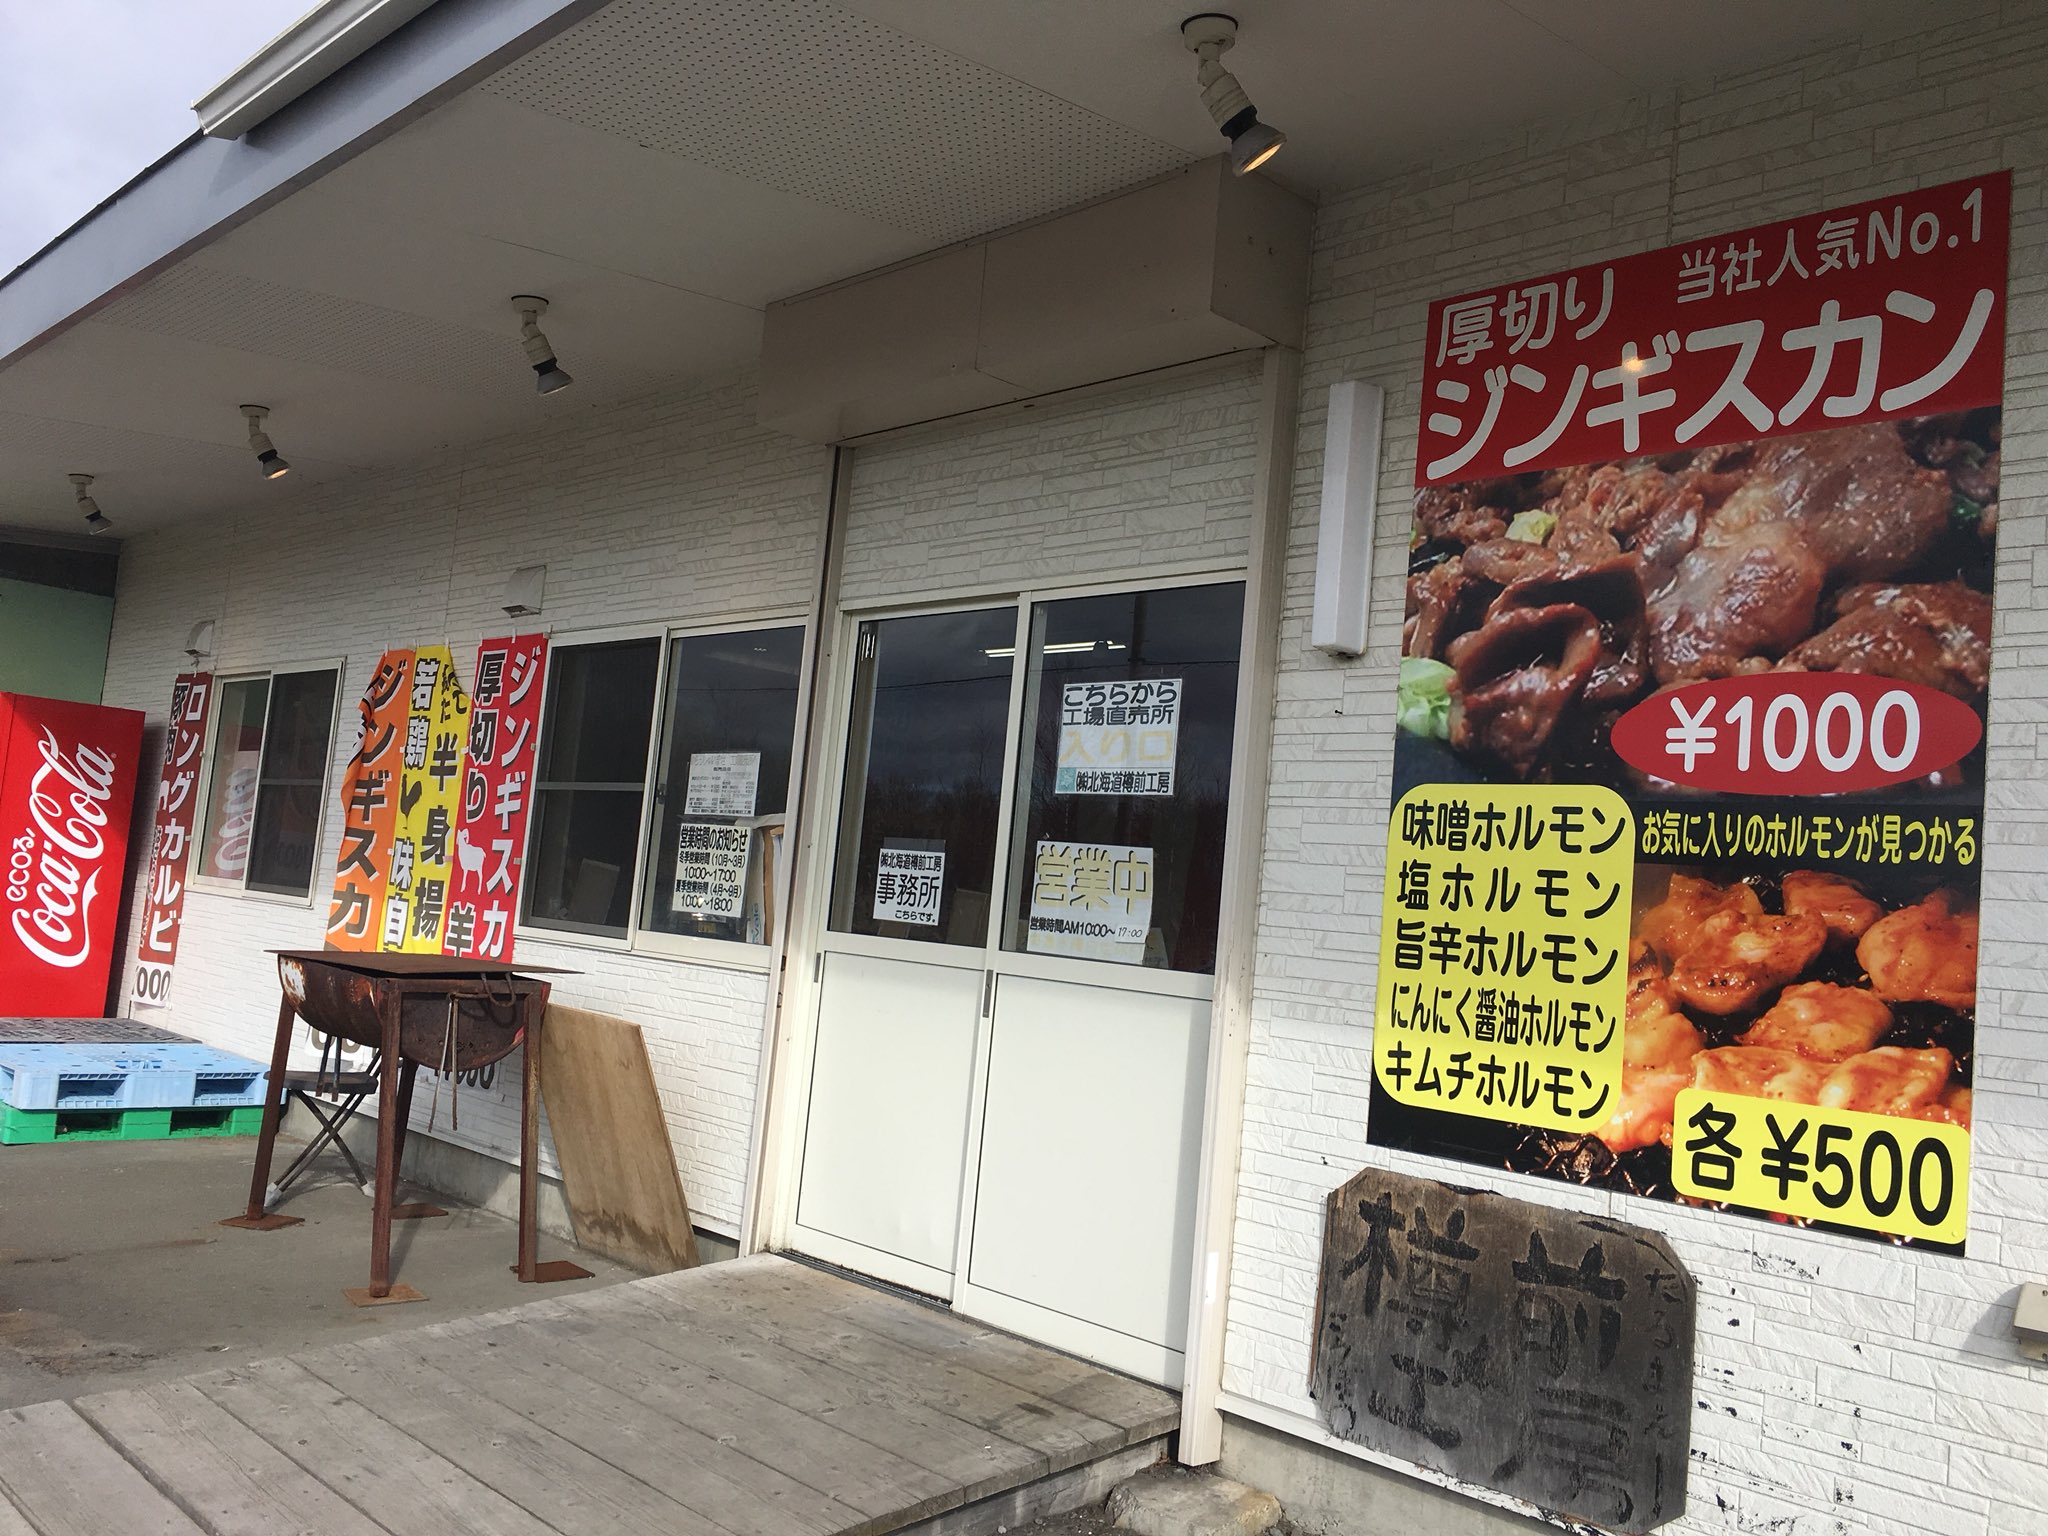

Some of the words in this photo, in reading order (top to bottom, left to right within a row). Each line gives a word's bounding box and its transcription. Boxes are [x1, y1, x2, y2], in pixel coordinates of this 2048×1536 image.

[1435, 267, 1615, 368] 厚切り
[1677, 187, 1984, 304] 当社人気No.1
[1426, 288, 1995, 481] ジンギスカン
[404, 658, 439, 770] 若鶏
[1063, 704, 1174, 726] 工場直売所
[1064, 681, 1177, 706] こちらから
[466, 650, 506, 823] 厚切り
[1060, 730, 1173, 764] 入り口
[1665, 690, 1921, 773] ¥1000
[149, 684, 206, 952] ロングカルビ
[327, 658, 407, 951] ジンギスカ
[680, 825, 748, 852] 営業時間のお知らせ
[1402, 802, 1626, 855] 味噌ホルモン
[1641, 809, 1976, 866] お気に入りのホルモンが見つかる
[12, 723, 116, 968] Coca-Cola
[1034, 844, 1153, 915] 営業中
[384, 837, 415, 952] 味自
[877, 871, 940, 909] 事務所
[1397, 862, 1621, 921] 塩ホルモン
[132, 966, 170, 1001] 000
[1394, 920, 1619, 985] 旨辛ホルモン
[1390, 981, 1618, 1053] にんにく醤油ホルモン
[1384, 1041, 1611, 1120] キムチホルモン
[1685, 1102, 1744, 1190] 各
[1760, 1112, 1954, 1228] ¥500
